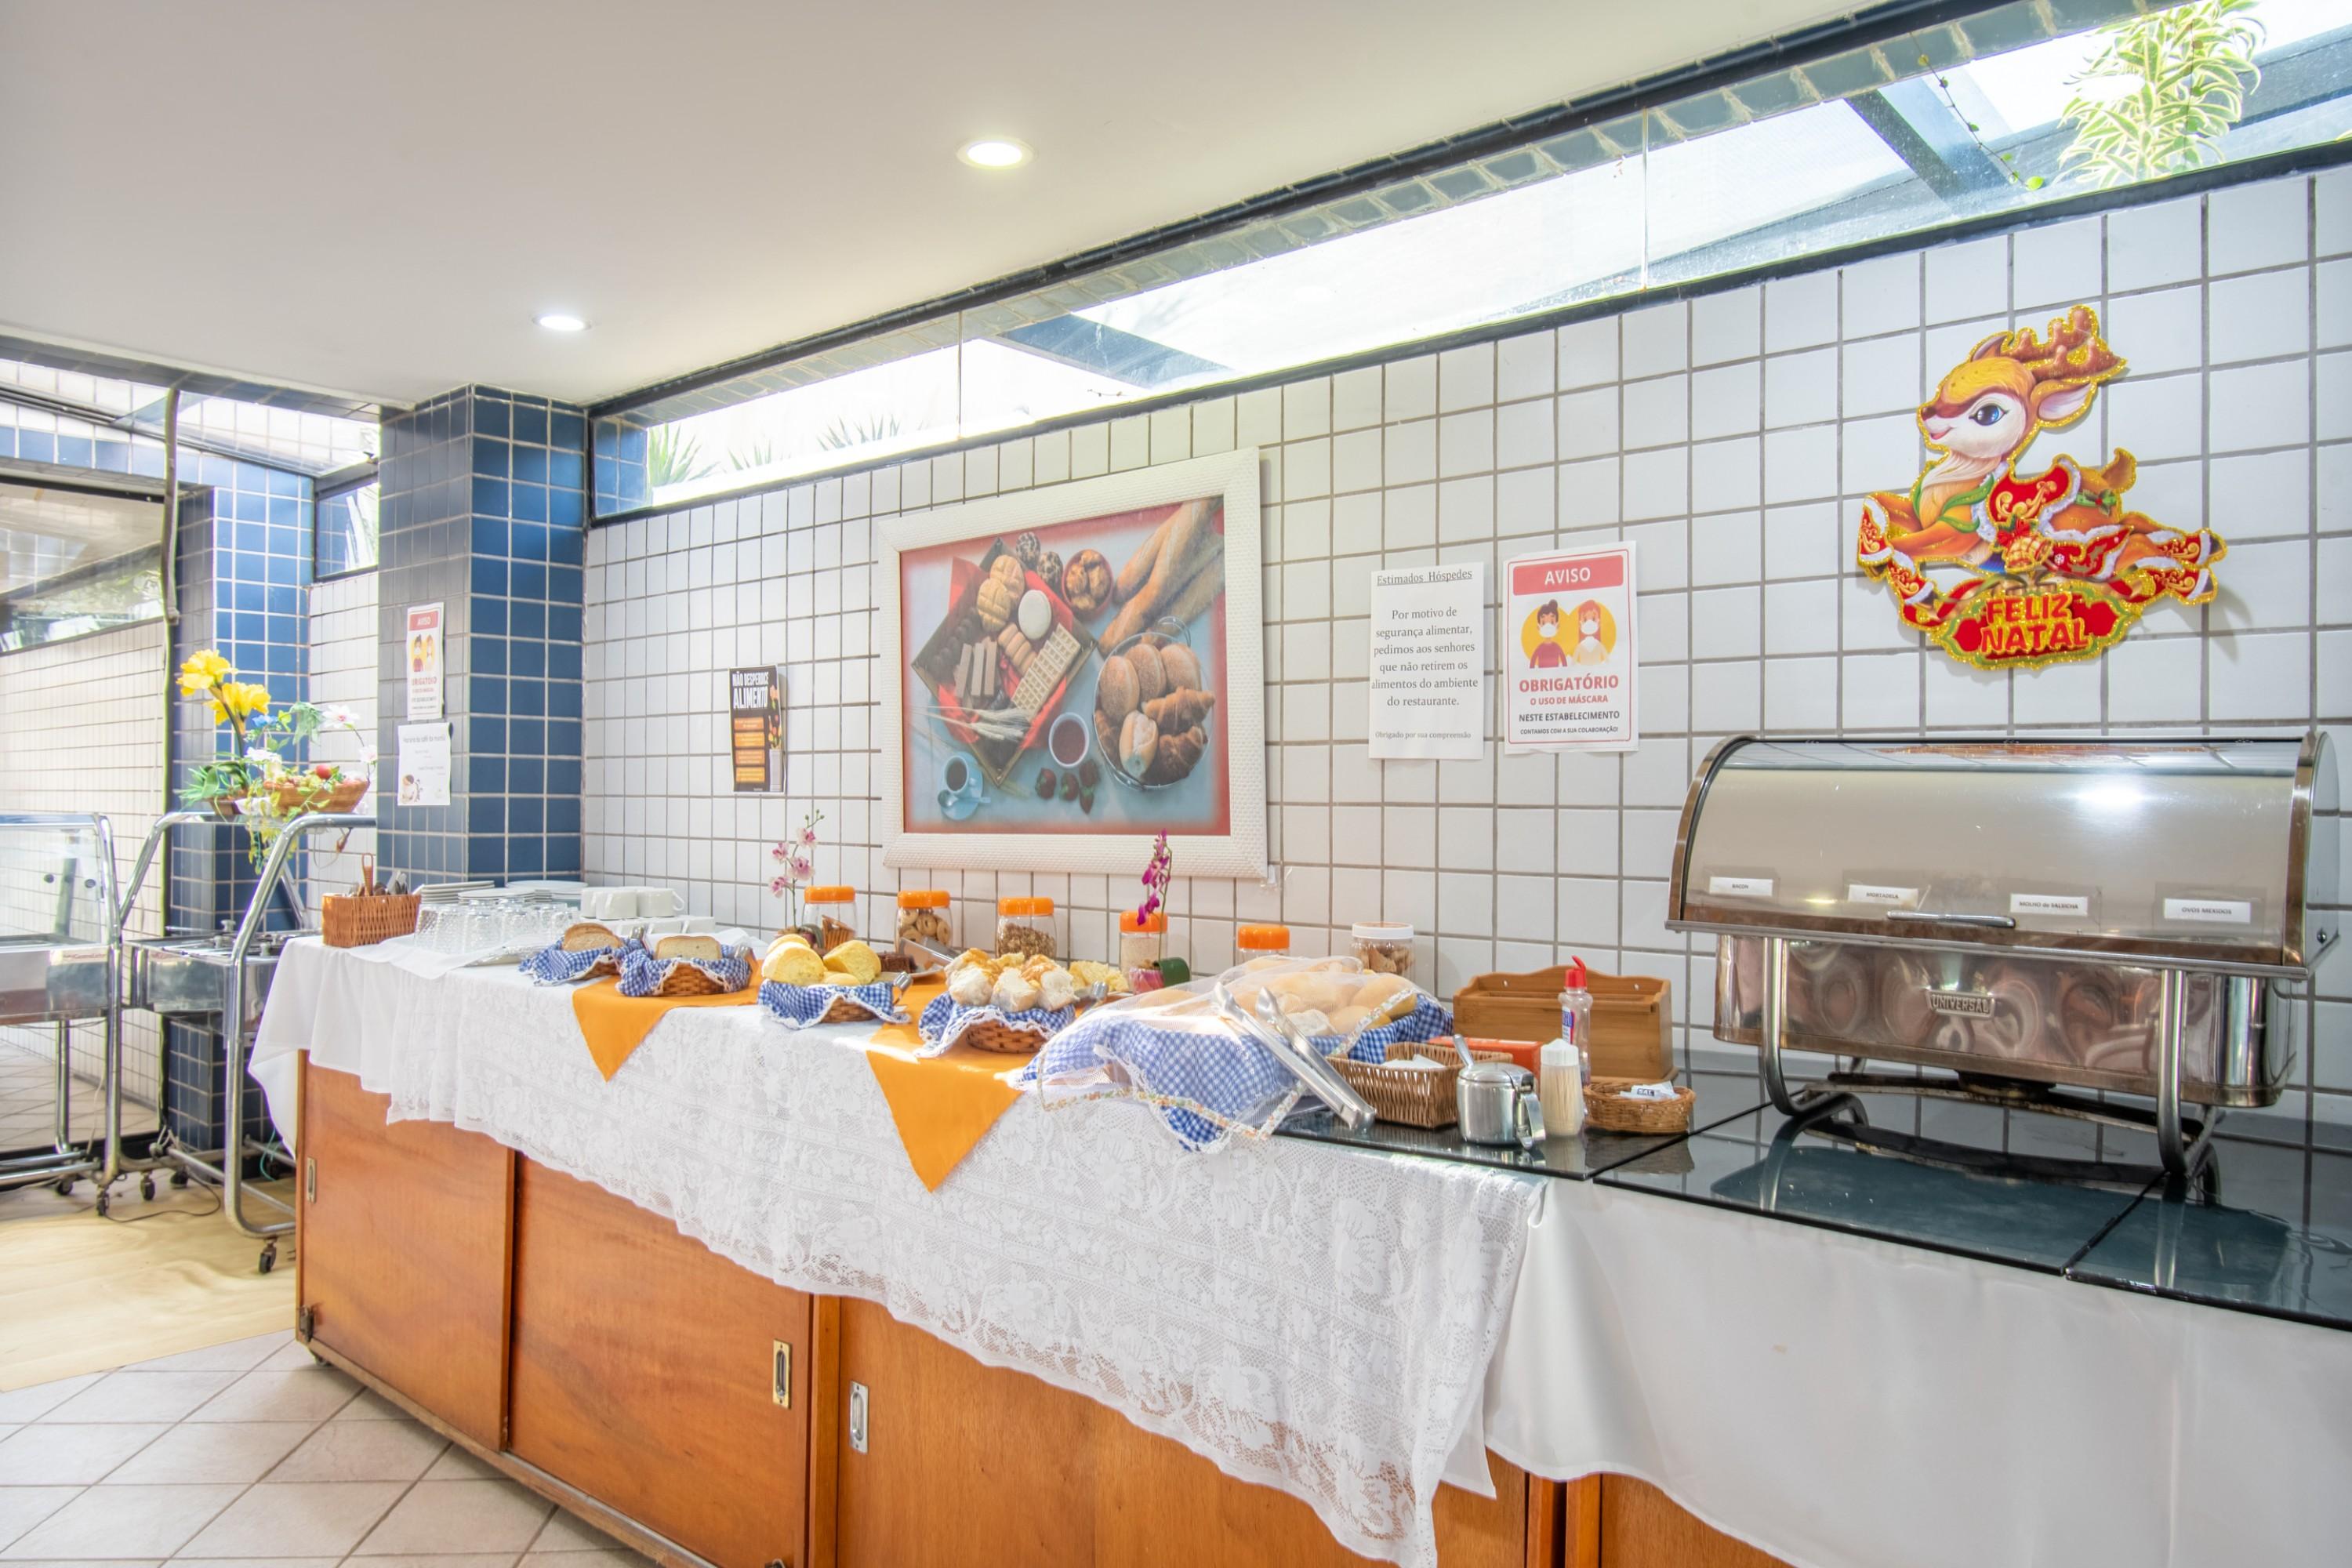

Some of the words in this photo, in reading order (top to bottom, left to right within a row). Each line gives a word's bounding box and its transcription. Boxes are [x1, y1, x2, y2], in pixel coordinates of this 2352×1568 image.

[1377, 573, 1424, 586] Estimados
[1428, 569, 1473, 582] Hóspedes
[1544, 567, 1591, 586] AVISO
[1392, 609, 1409, 619] Por
[1411, 608, 1443, 619] motivo
[1446, 606, 1457, 617] de
[1986, 591, 2072, 624] FELIZ
[1376, 630, 1423, 640] segurança
[1426, 625, 1472, 636] alimentar,
[1980, 619, 2089, 654] NATAL
[1374, 644, 1414, 658] pedimos
[1416, 645, 1432, 654] aos
[1434, 641, 1475, 652] senhores
[1380, 663, 1397, 674] que
[1400, 662, 1418, 671] não
[1421, 660, 1455, 670] retirem
[1371, 678, 1417, 689] alimentos
[1419, 678, 1432, 688] do
[1434, 677, 1479, 688] ambiente
[1519, 673, 1619, 692] OBRIGATÓRIO
[1387, 695, 1400, 706] do
[1403, 696, 1460, 706] restaurante.
[1538, 697, 1555, 706] USO
[1568, 694, 1609, 704] MÁSCARA
[1519, 713, 1544, 722] NESTE
[1545, 710, 1621, 721] ESTABELECIMENTO
[1375, 731, 1404, 739] Obrigado
[1429, 731, 1472, 739] compreensão
[1931, 993, 1990, 1014] UNIVERSAL
